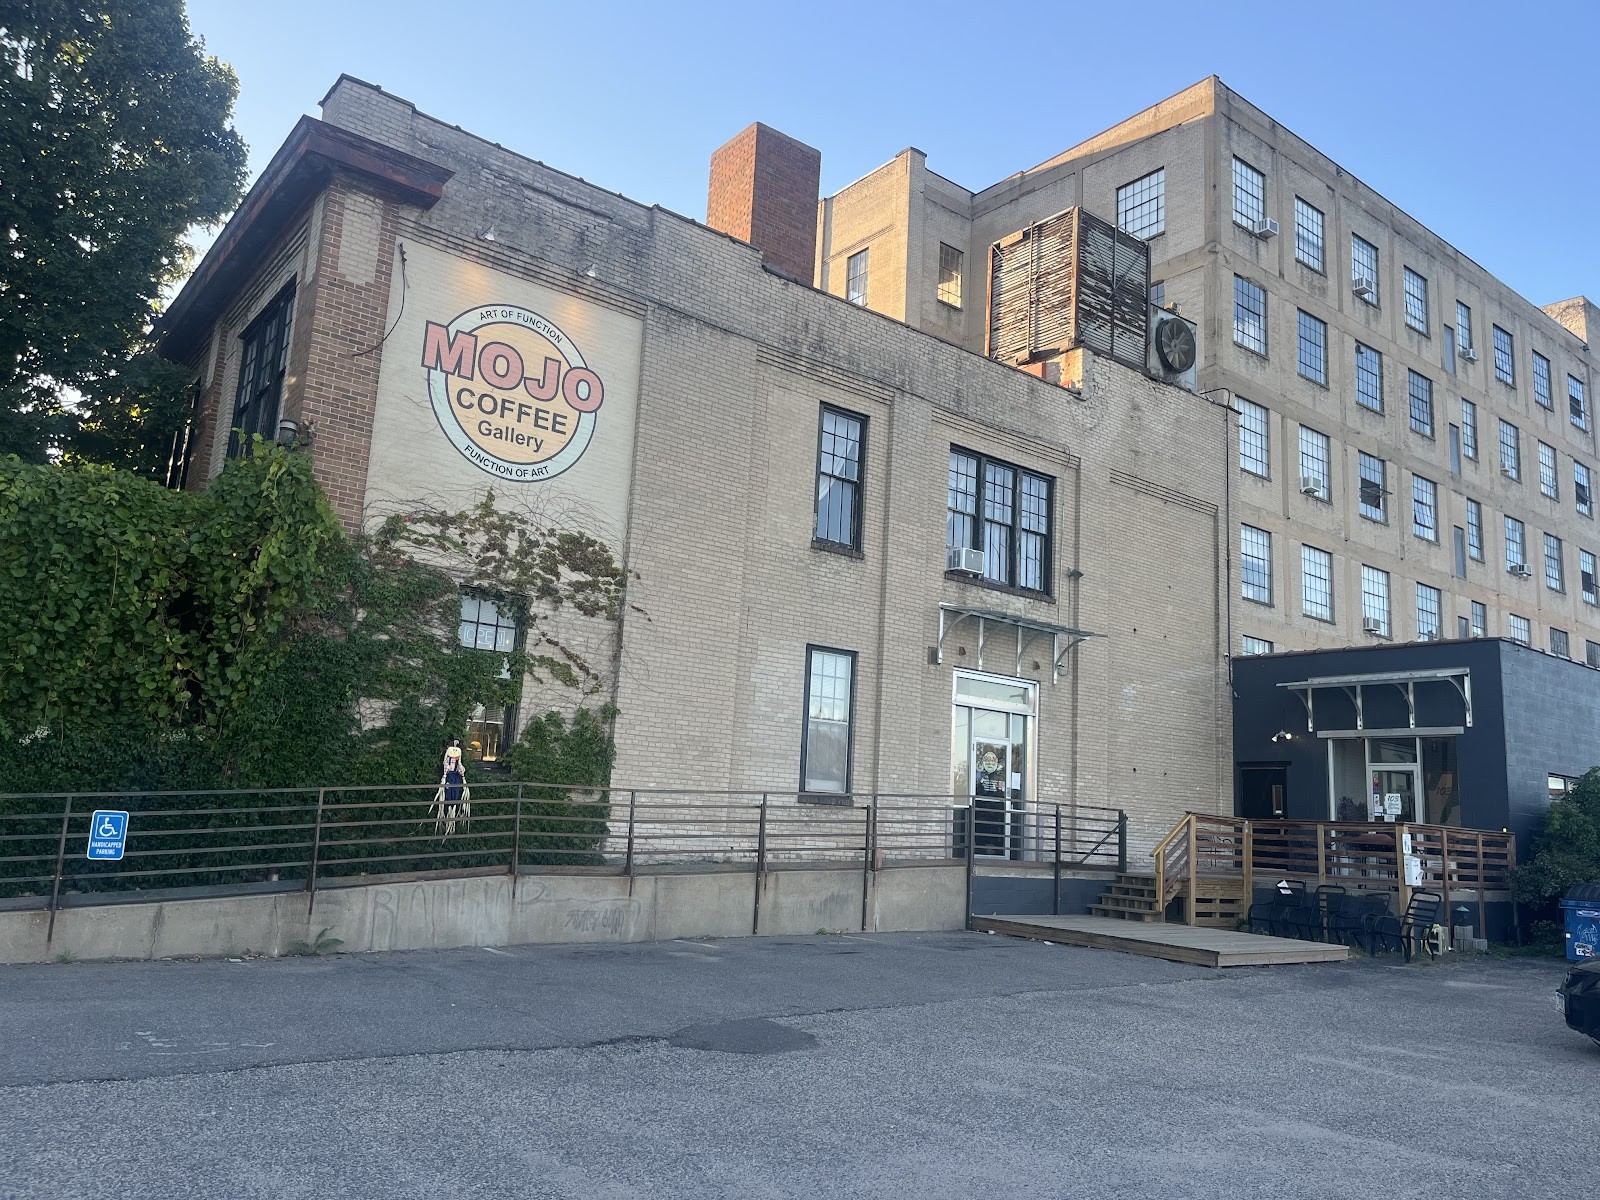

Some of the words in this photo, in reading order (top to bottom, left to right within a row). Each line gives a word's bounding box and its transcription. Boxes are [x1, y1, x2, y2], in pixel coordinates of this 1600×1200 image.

[480, 309, 498, 321] ART
[500, 309, 514, 319] OF
[516, 312, 563, 344] FUNCTION
[421, 320, 604, 414] MOJO
[456, 387, 568, 436] COFFEE
[477, 420, 544, 453] Gallery
[464, 444, 513, 476] FUNCTION
[515, 468, 530, 478] OF
[531, 465, 550, 477] ART
[466, 628, 504, 645] OPEN
